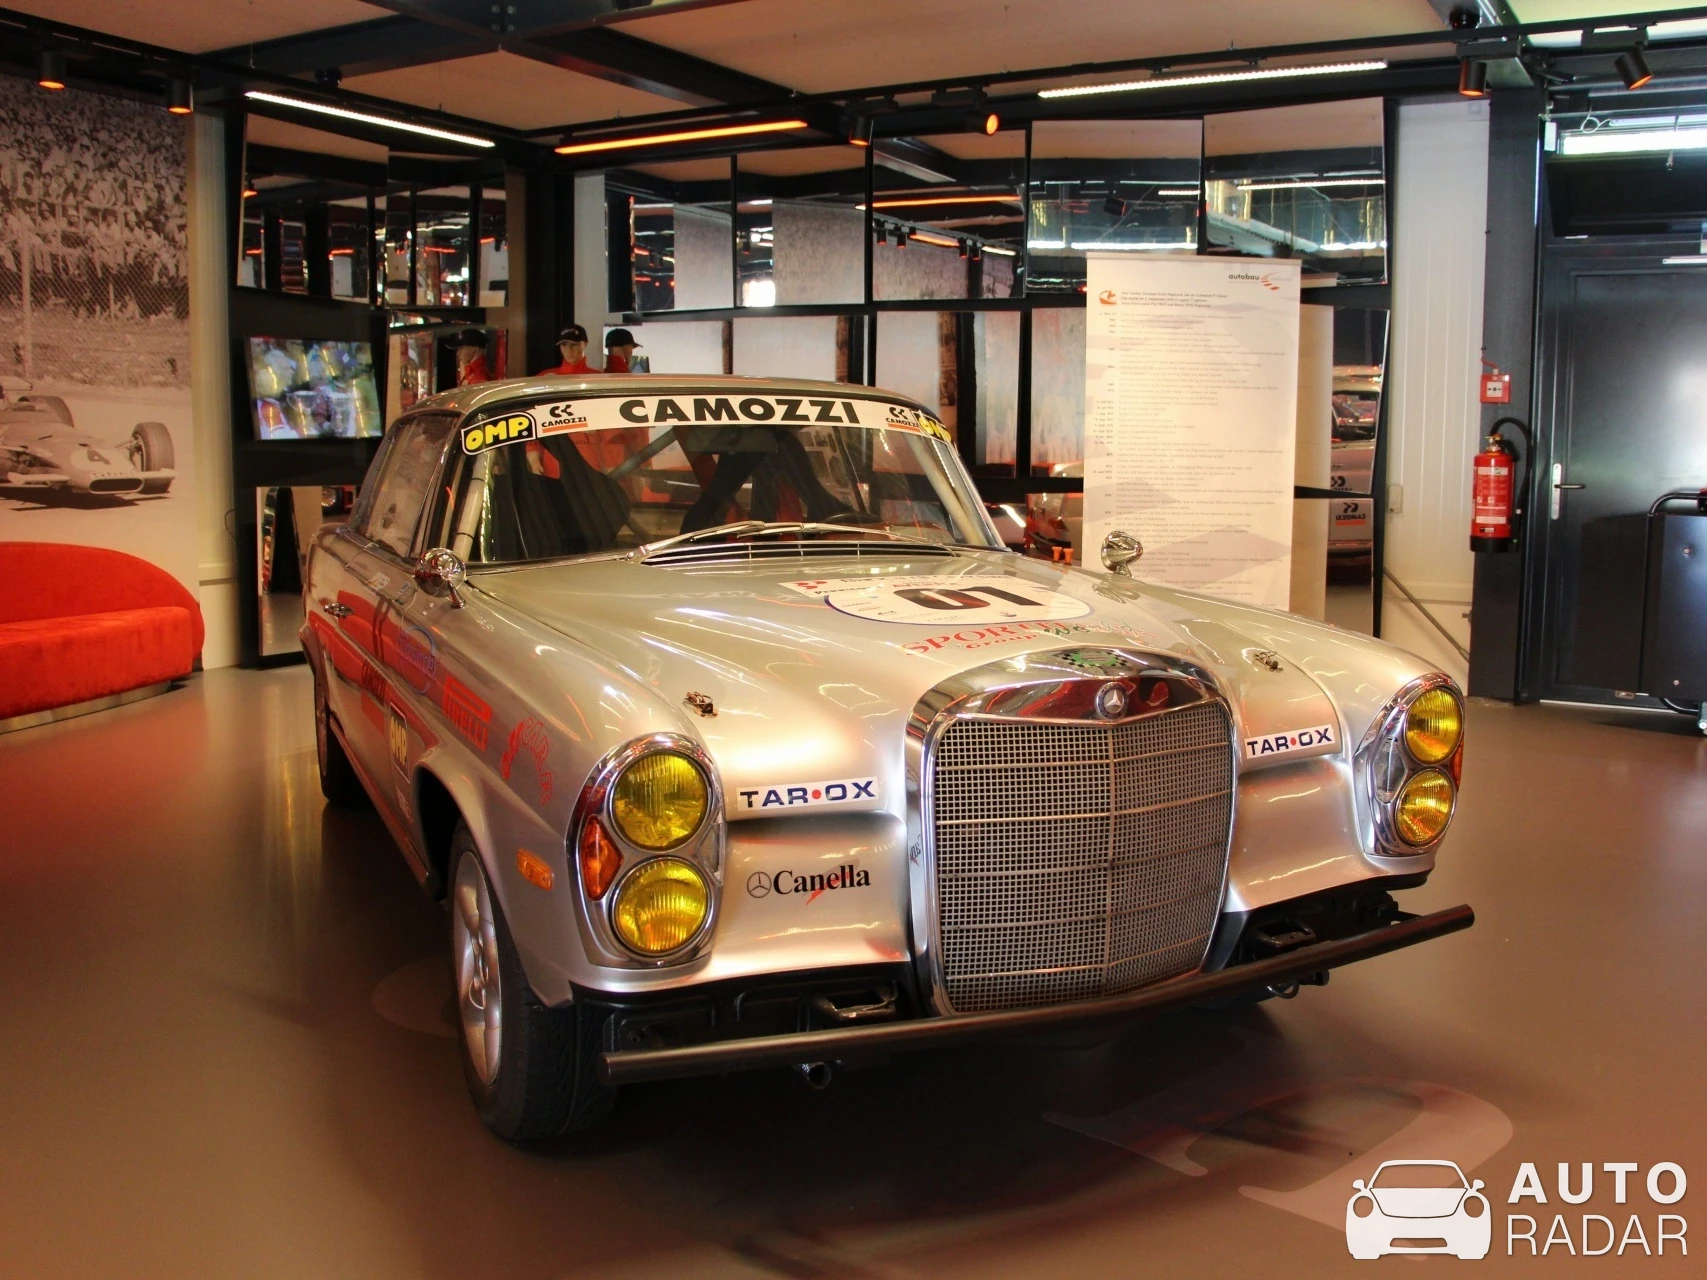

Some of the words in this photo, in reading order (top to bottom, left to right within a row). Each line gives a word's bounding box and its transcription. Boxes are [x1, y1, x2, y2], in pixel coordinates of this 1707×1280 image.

[541, 416, 588, 428] CAMOZZI
[620, 397, 860, 424] CAMOZZI
[465, 416, 530, 451] OMP
[893, 585, 1046, 610] 01
[773, 864, 871, 895] Canella
